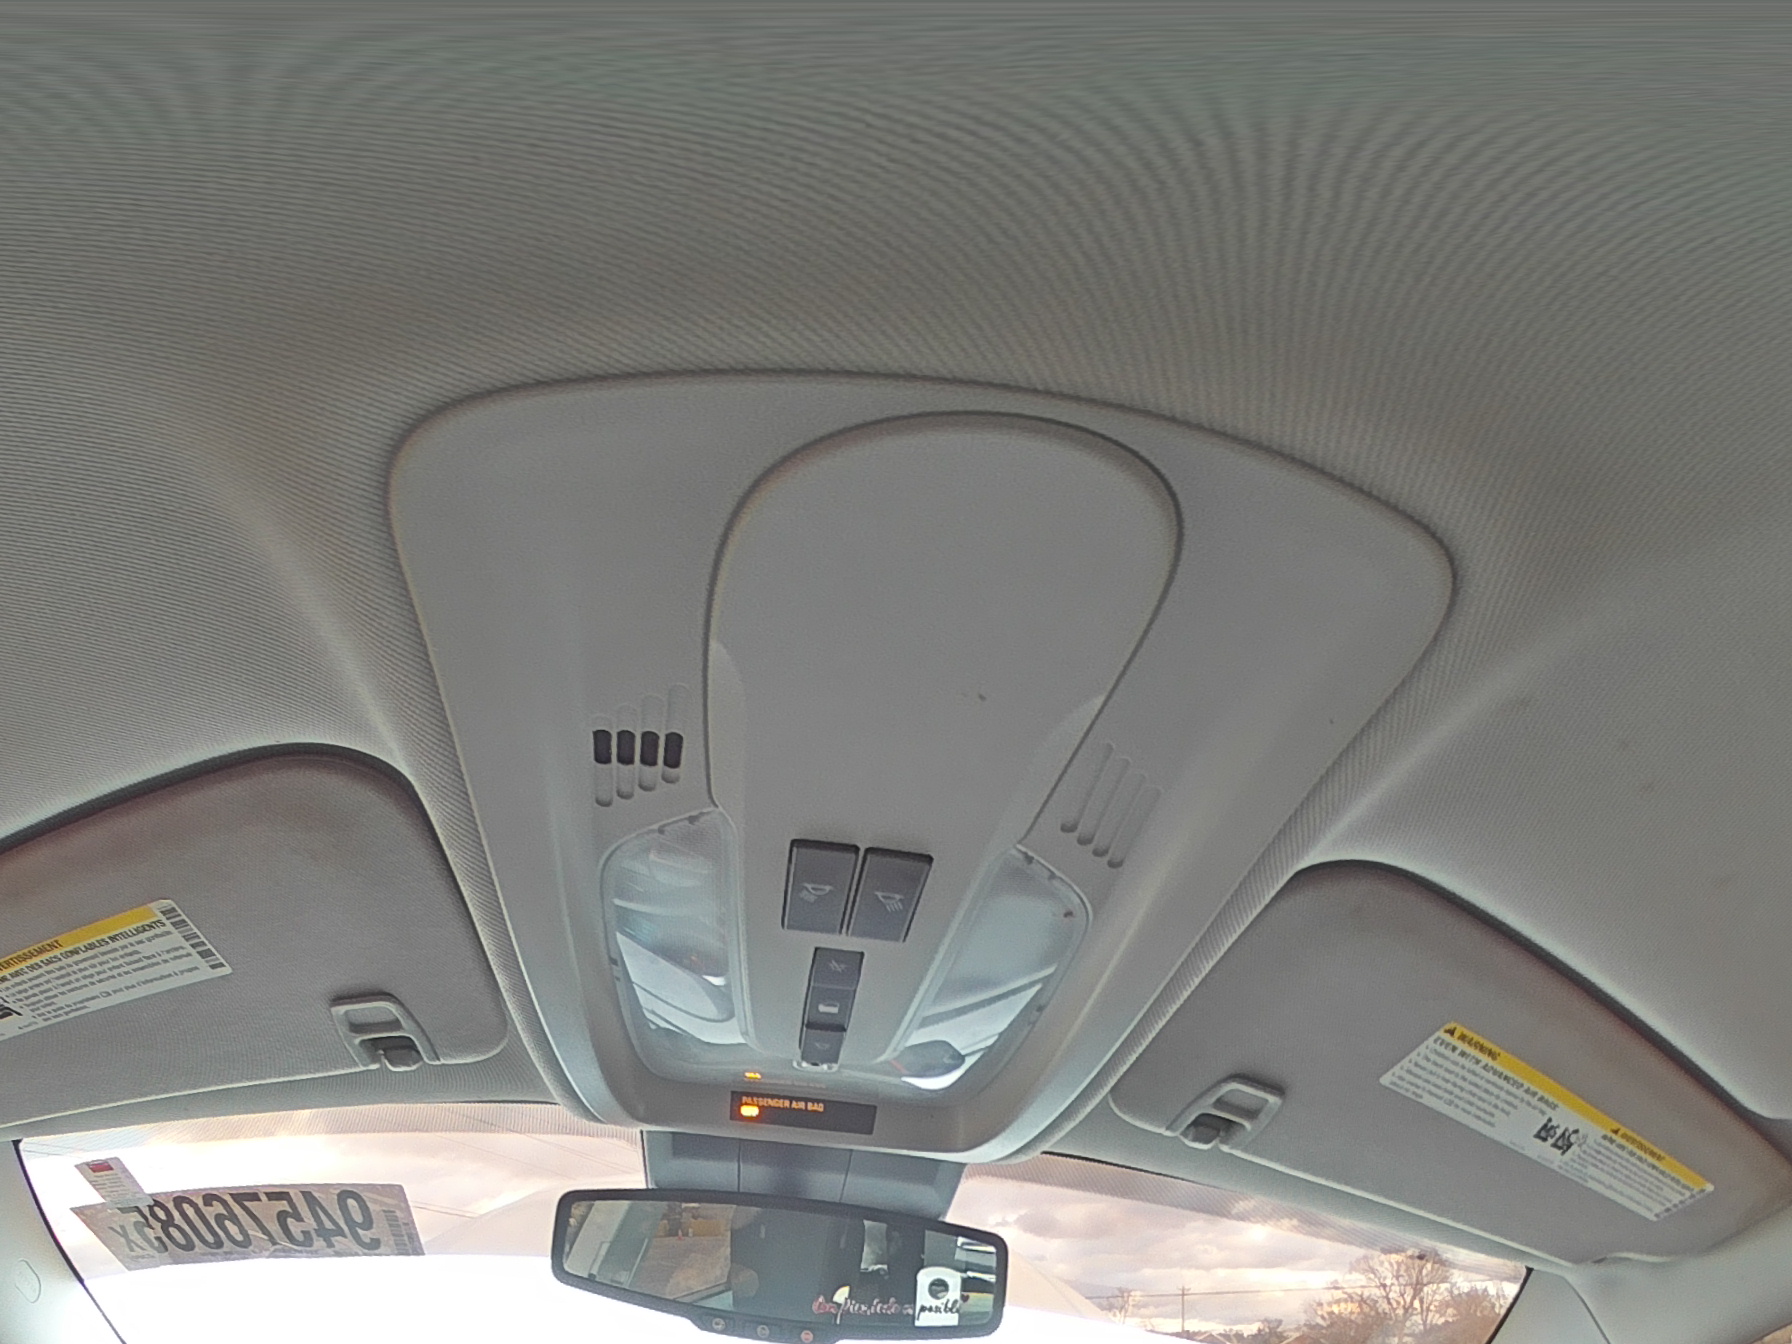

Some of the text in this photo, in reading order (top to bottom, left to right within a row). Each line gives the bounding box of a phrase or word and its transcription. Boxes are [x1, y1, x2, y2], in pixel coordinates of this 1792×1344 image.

[107, 919, 167, 943] INTELLIGENTS
[742, 1096, 824, 1112] PASSENGER AIR BAG
